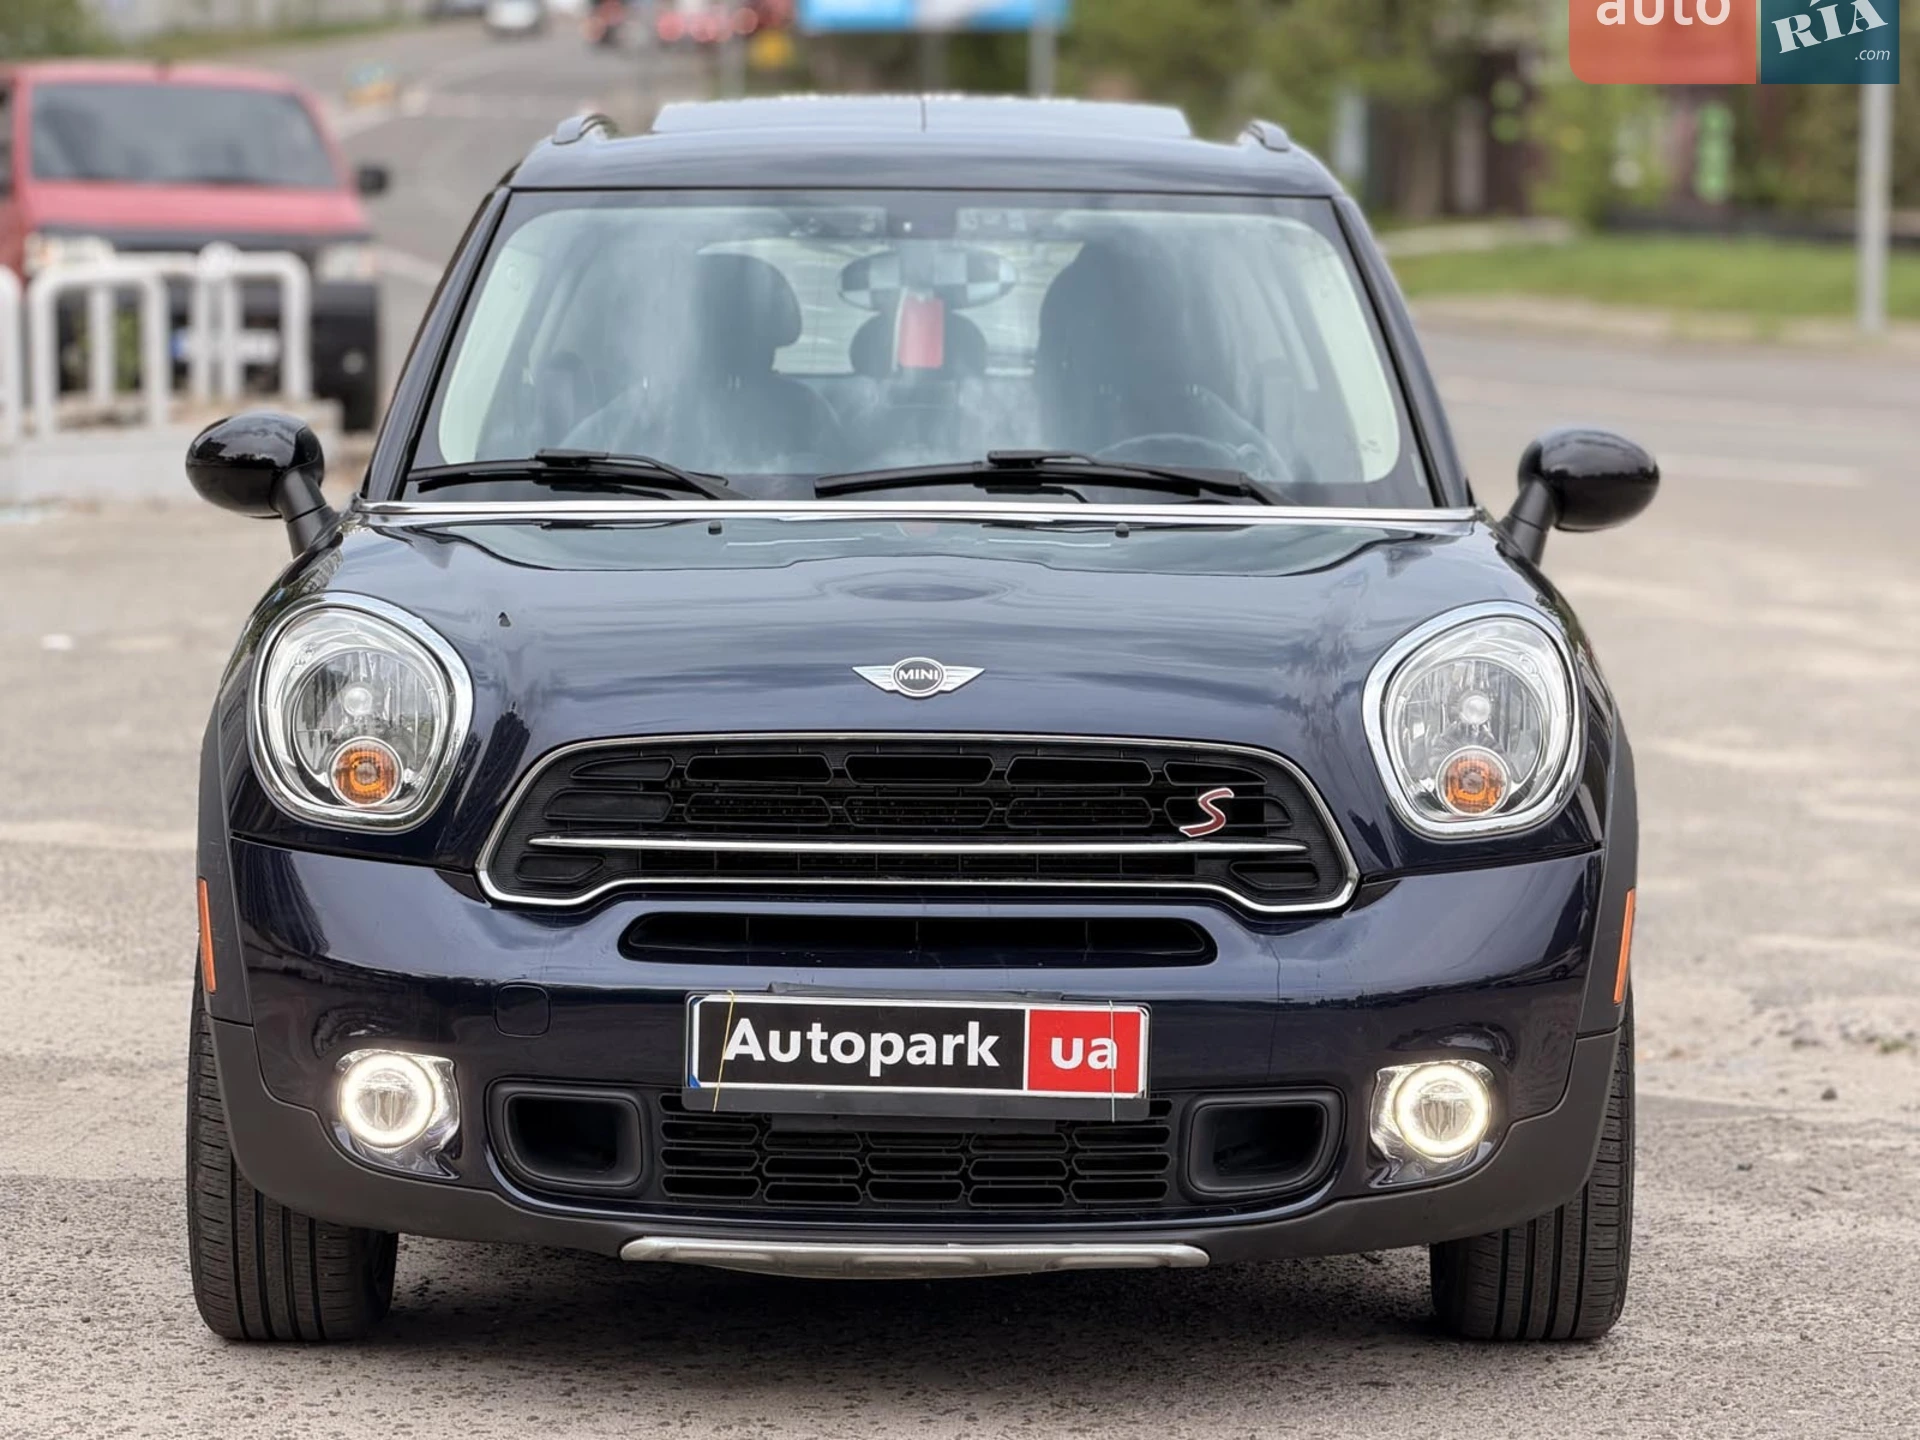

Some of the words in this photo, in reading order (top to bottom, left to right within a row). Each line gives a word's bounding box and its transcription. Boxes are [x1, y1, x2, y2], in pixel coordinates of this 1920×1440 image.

[898, 668, 939, 681] MINI
[1178, 786, 1235, 838] S
[723, 1017, 1000, 1078] Autopark
[1050, 1035, 1118, 1070] ua
